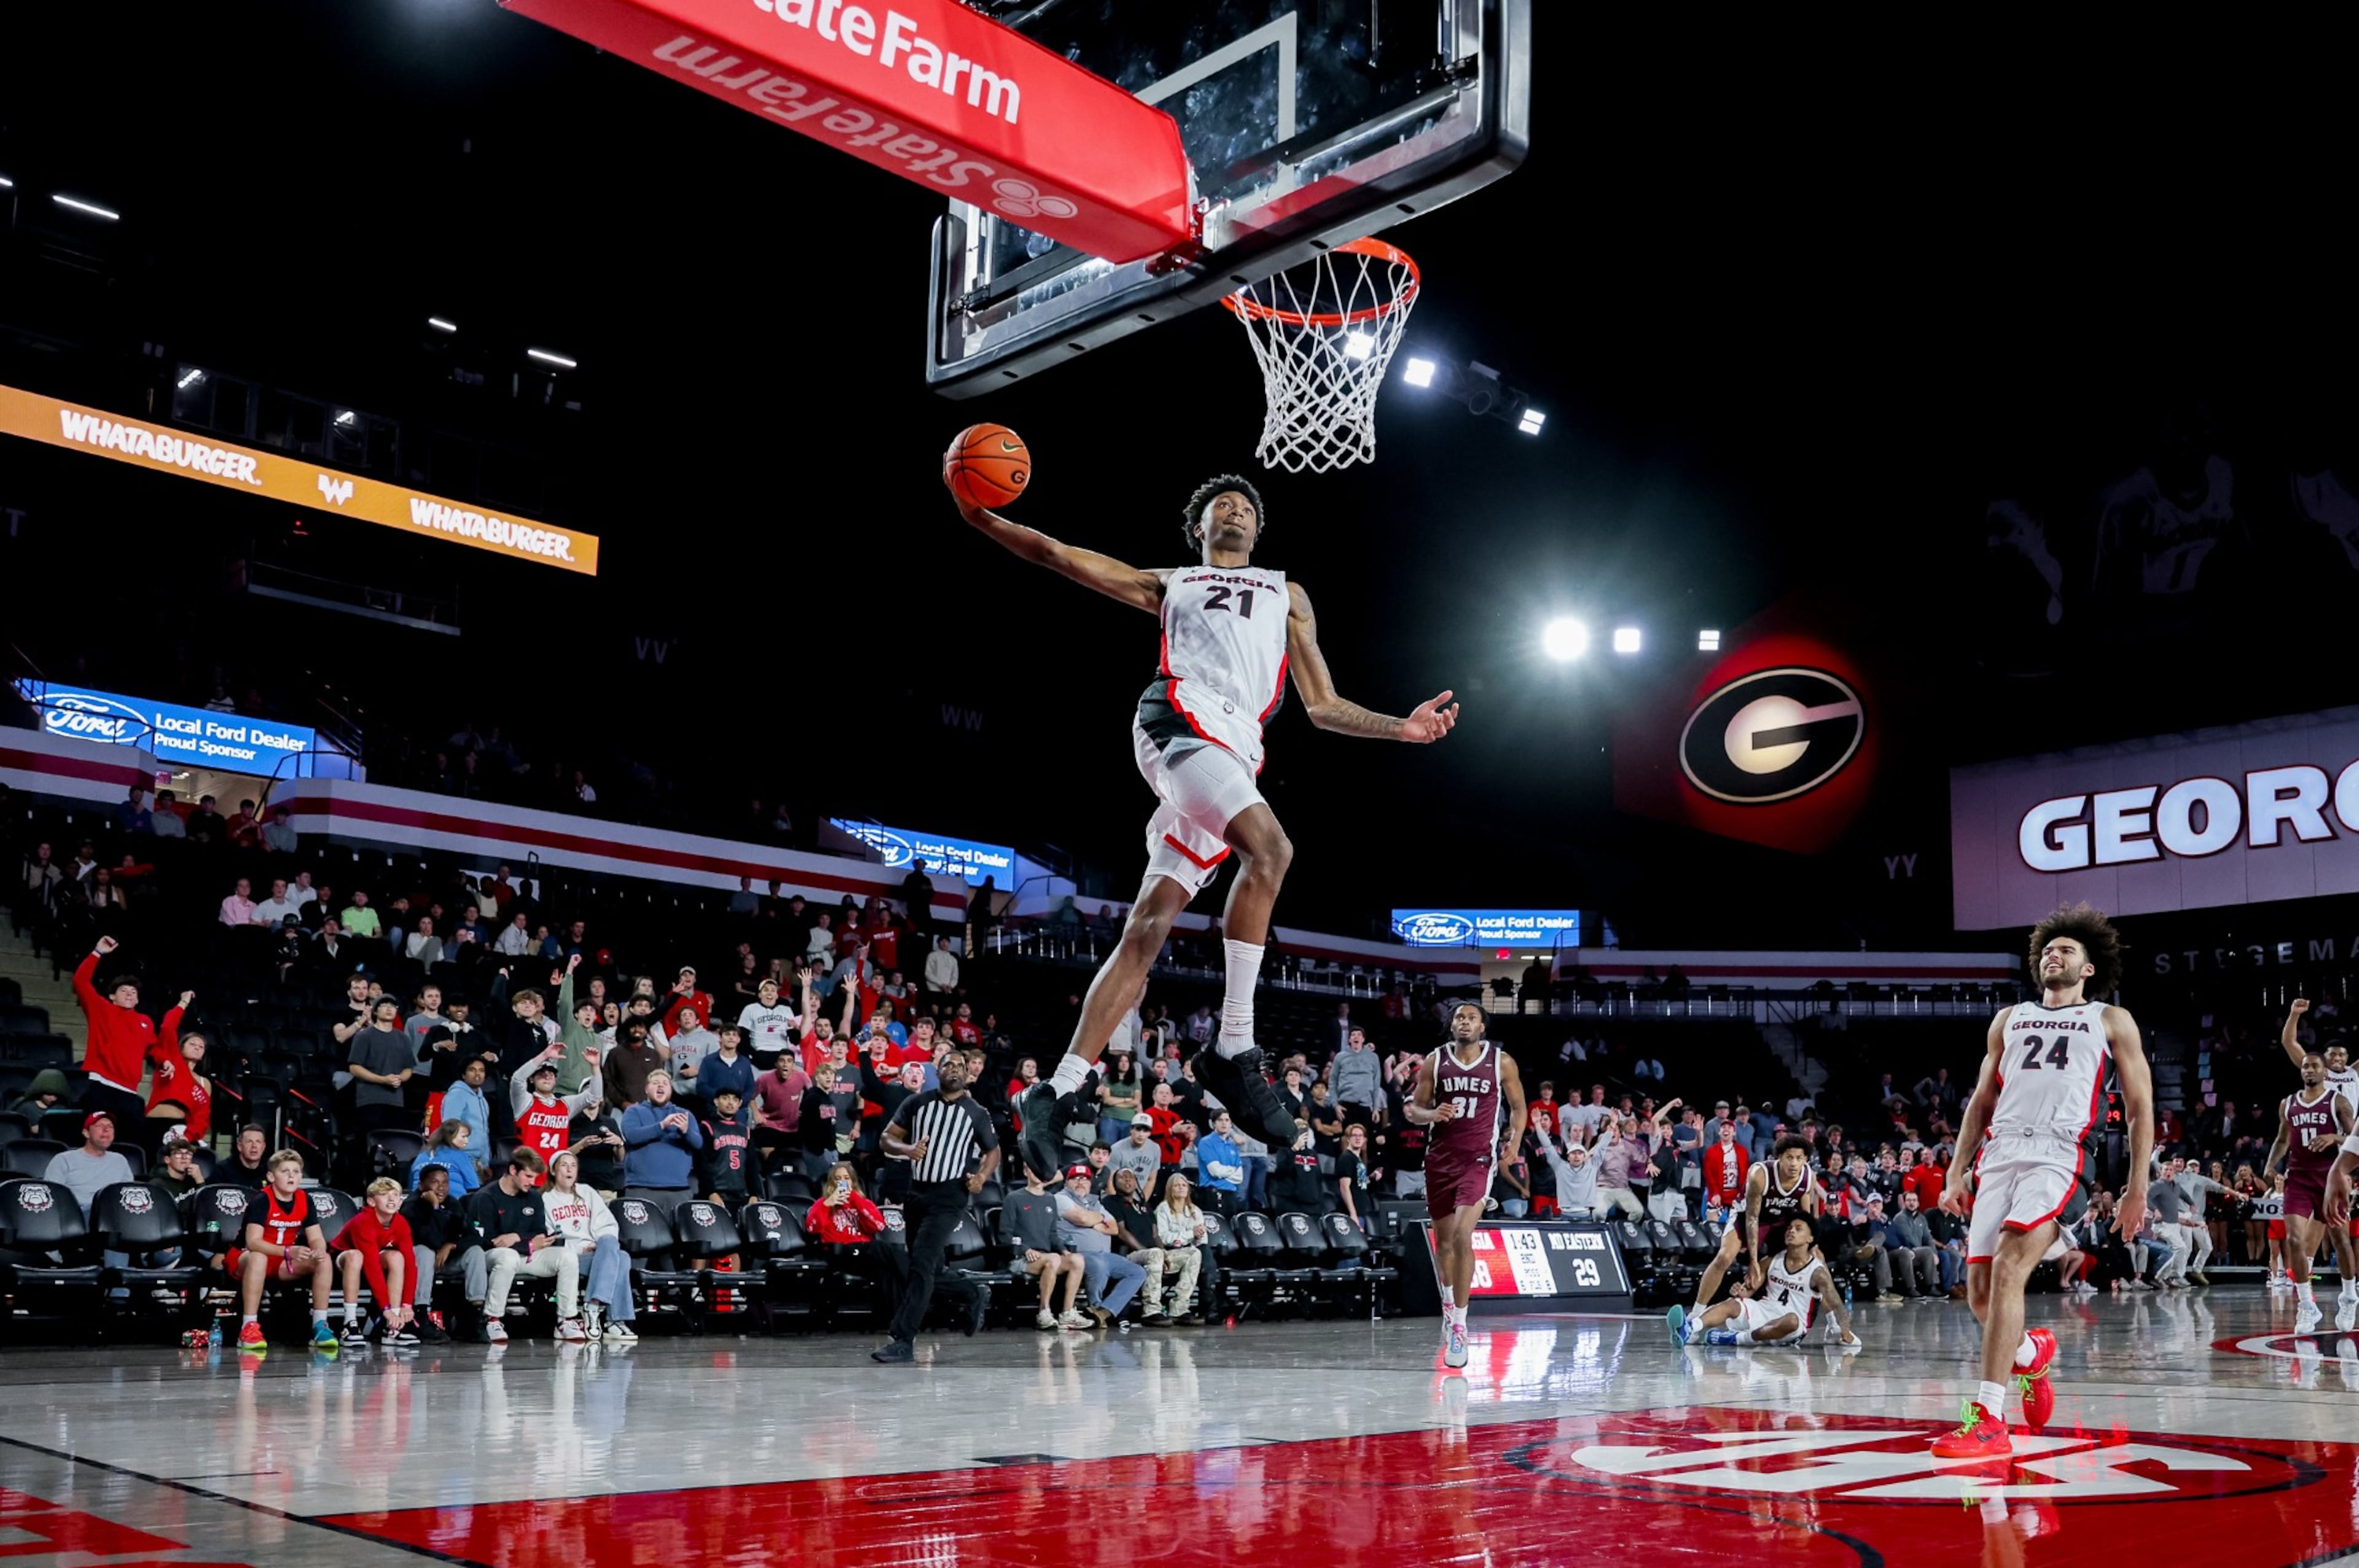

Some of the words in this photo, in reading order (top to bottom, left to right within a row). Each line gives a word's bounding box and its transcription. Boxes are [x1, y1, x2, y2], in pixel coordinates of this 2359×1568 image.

[60, 410, 260, 486] WHATABURGER
[1011, 470, 1025, 484] G
[410, 498, 573, 562] WHATABURGER
[1182, 574, 1278, 594] GEORGIA
[1203, 585, 1254, 620] 21
[45, 698, 126, 738] Ford
[155, 713, 201, 735] Local
[206, 720, 247, 743] Ford
[251, 727, 307, 752] Dealer
[154, 734, 197, 752] Proud
[200, 742, 256, 761] Sponsor
[916, 841, 944, 857] Local
[947, 846, 973, 863] Ford
[974, 849, 1009, 868] Dealer
[1884, 852, 1919, 880] YY
[1411, 916, 1460, 938] Ford
[1476, 917, 1505, 928] Local
[1508, 917, 1534, 928] Ford
[1536, 917, 1575, 929] Dealer
[1477, 929, 1504, 939] Proud
[1505, 929, 1542, 940] Sponsor
[2012, 1021, 2090, 1033] GEORGIA
[2021, 1035, 2069, 1070] 24
[1442, 1077, 1492, 1094] UMES
[1452, 1097, 1478, 1118] 31
[2291, 1112, 2328, 1126] UMES
[540, 1133, 560, 1149] 24
[2301, 1128, 2317, 1147] 11
[729, 1150, 740, 1169] 5
[276, 1228, 286, 1244] 1
[1510, 1233, 1536, 1250] 1:43
[1566, 1233, 1605, 1250] EASTERN
[1573, 1259, 1600, 1286] 29
[1770, 1275, 1804, 1293] GEORGIA
[1778, 1289, 1789, 1306] 4
